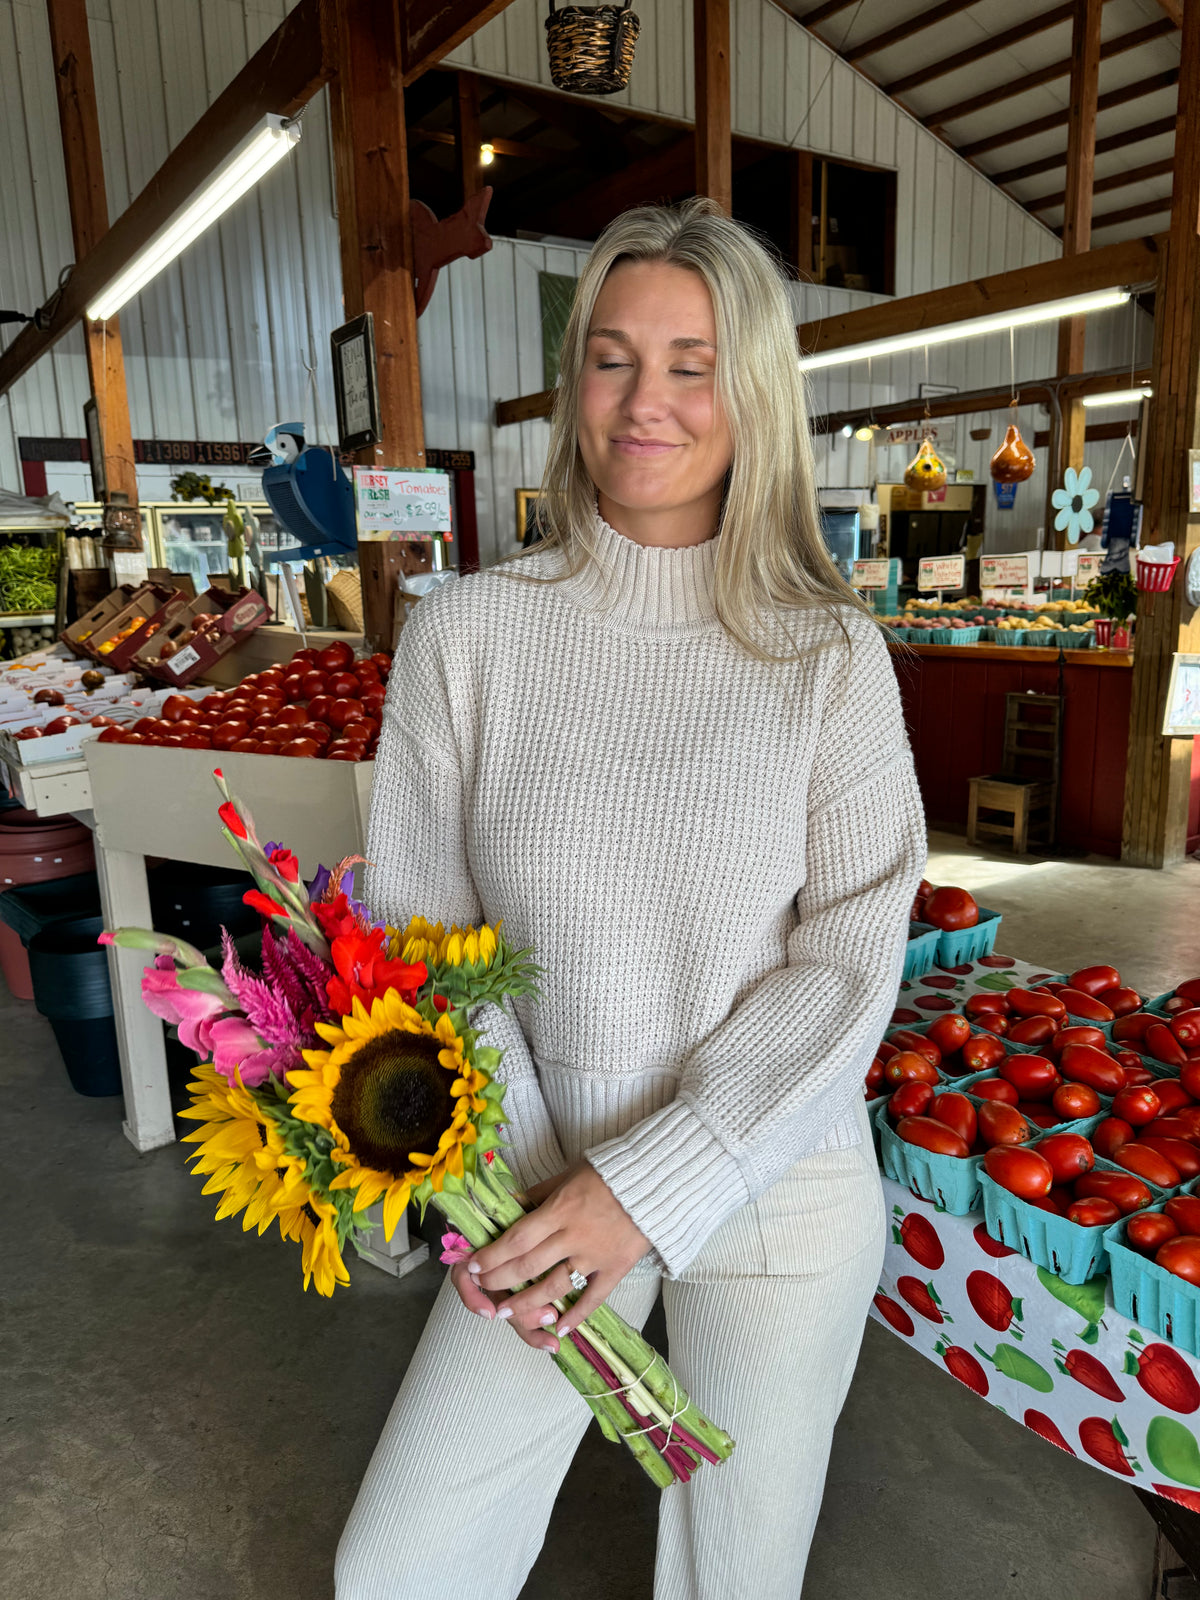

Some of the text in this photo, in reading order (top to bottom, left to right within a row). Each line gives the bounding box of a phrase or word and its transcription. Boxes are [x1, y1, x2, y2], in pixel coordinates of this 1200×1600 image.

[887, 426, 939, 443] APPLES
[156, 443, 190, 460] 1388
[206, 444, 241, 461] 1596
[360, 474, 389, 488] JERSEY
[394, 480, 447, 496] Tomatoes
[361, 488, 390, 501] FRESH
